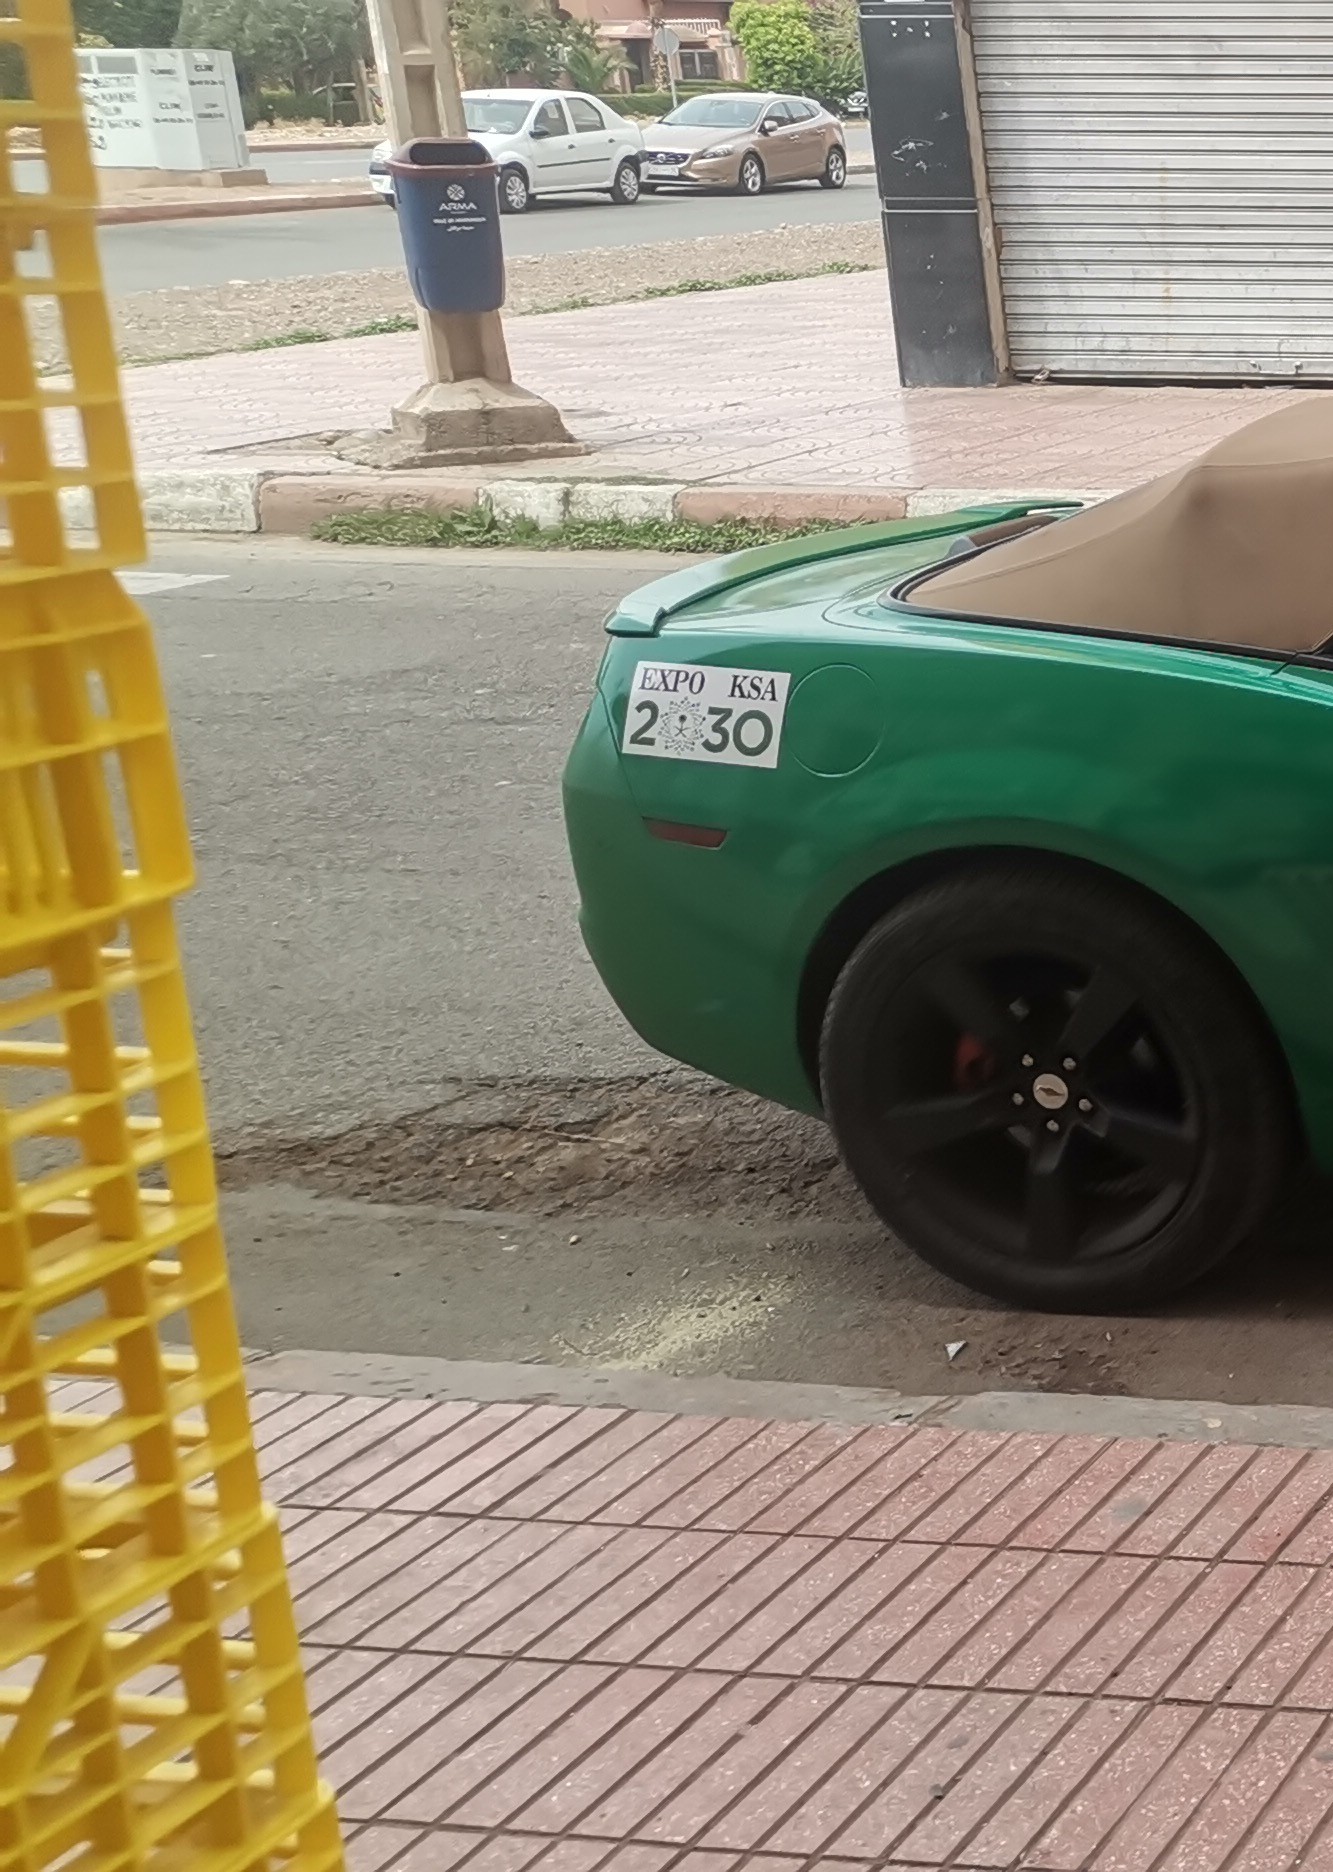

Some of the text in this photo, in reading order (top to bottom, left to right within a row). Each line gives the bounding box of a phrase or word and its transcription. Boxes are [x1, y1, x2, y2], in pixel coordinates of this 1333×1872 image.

[438, 202, 478, 211] ARMA
[638, 667, 778, 702] EXPO KSA
